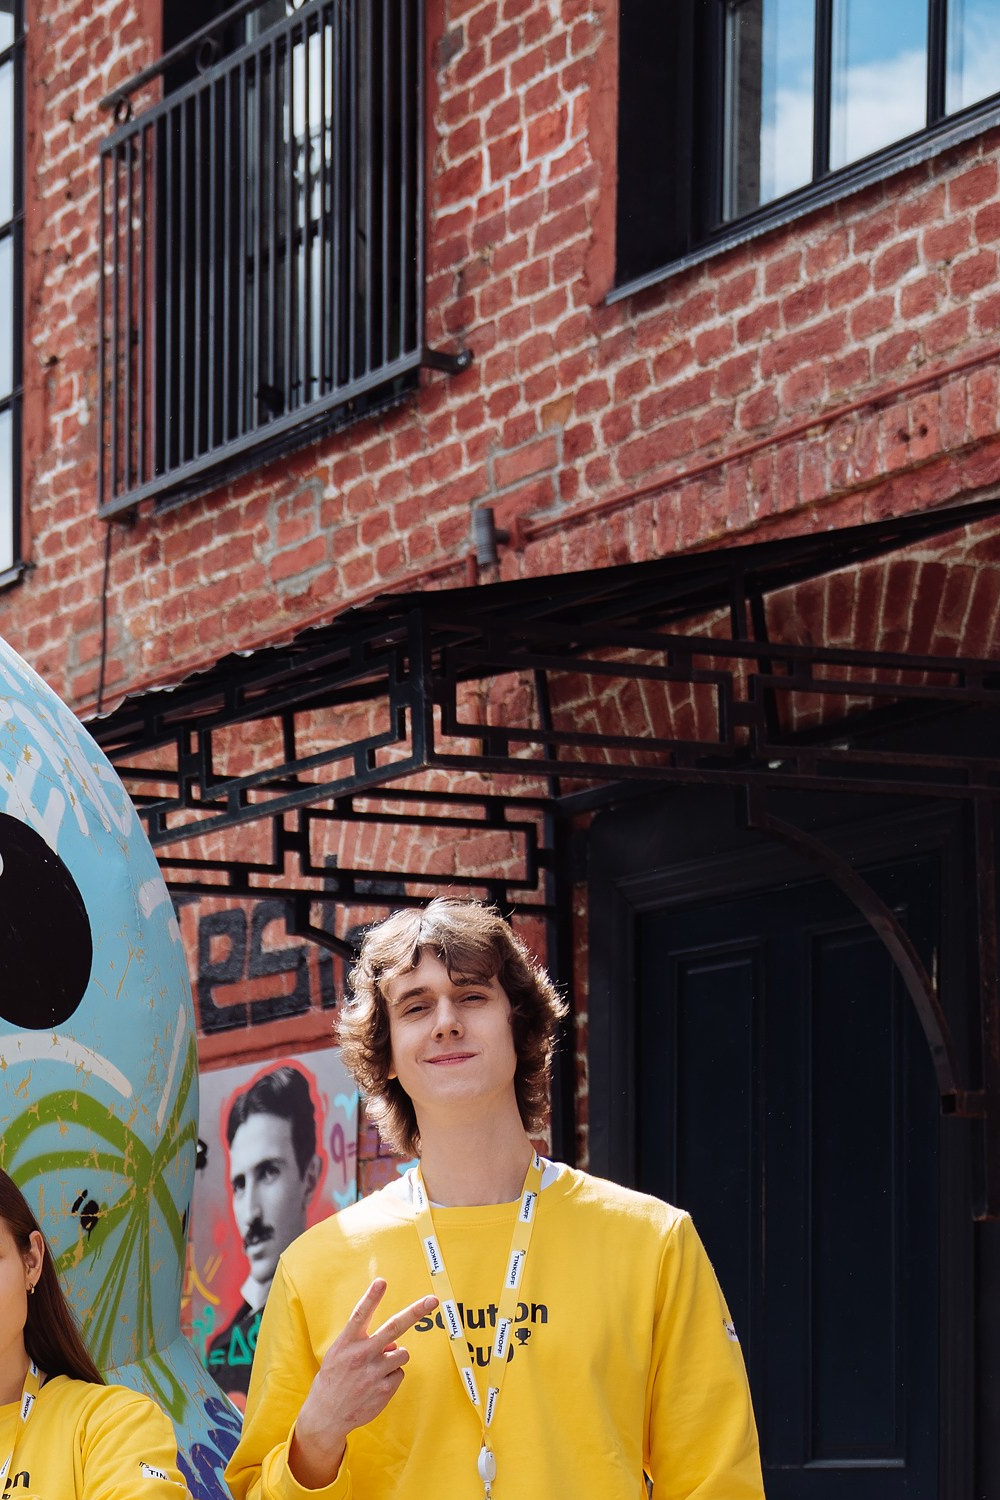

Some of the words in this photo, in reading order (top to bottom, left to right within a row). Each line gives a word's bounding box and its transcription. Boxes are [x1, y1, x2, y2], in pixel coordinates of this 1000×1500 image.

[523, 1194, 532, 1220] TINKOFF
[510, 1254, 520, 1286] TINKOFF
[446, 1304, 459, 1335] TINKOFF
[497, 1322, 507, 1355] TINKOFF
